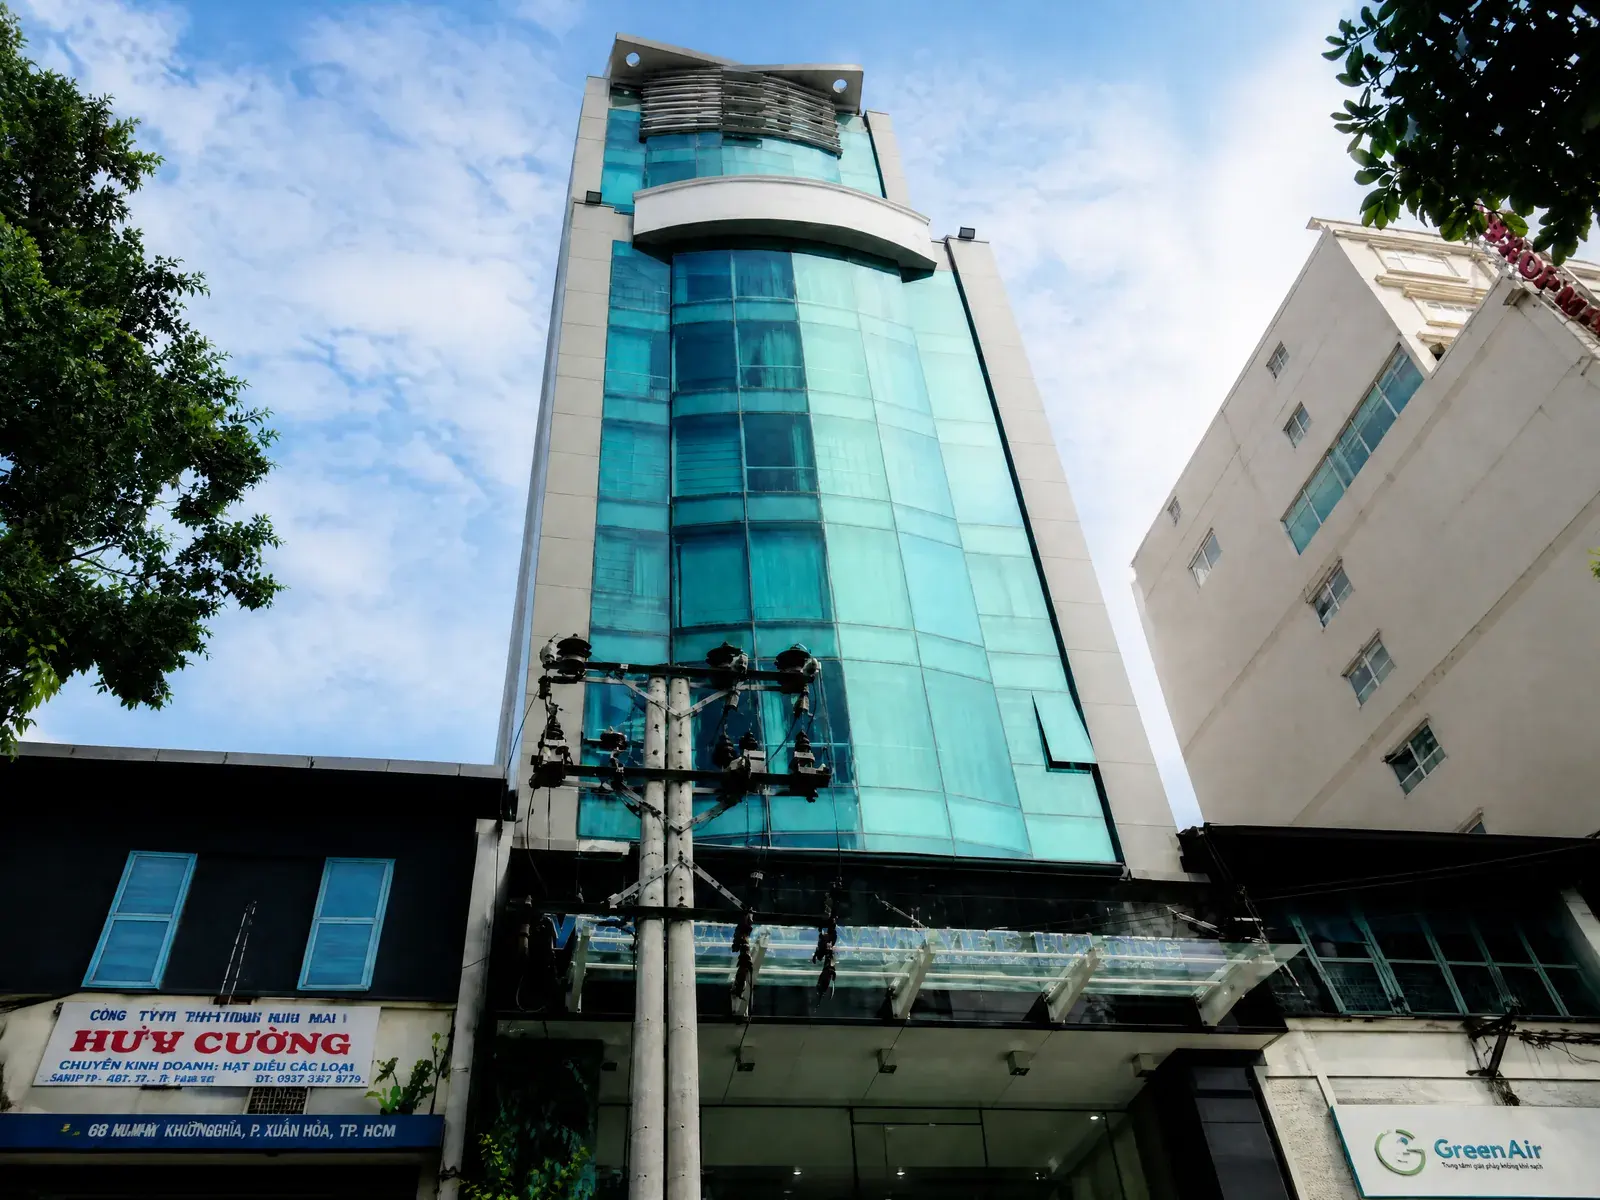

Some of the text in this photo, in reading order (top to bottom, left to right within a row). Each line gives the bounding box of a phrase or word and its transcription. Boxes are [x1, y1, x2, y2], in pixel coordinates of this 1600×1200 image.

[194, 1026, 352, 1056] CƯỜNG
[59, 1057, 124, 1071] CHUYÊN
[124, 1061, 160, 1071] KINH
[162, 1061, 219, 1072] DOANH:
[222, 1062, 251, 1073] HẠT
[277, 1075, 305, 1084] 0937
[88, 1123, 110, 1138] 68
[249, 1124, 261, 1138] P.
[339, 1124, 359, 1138] TP.
[363, 1124, 397, 1138] HCM
